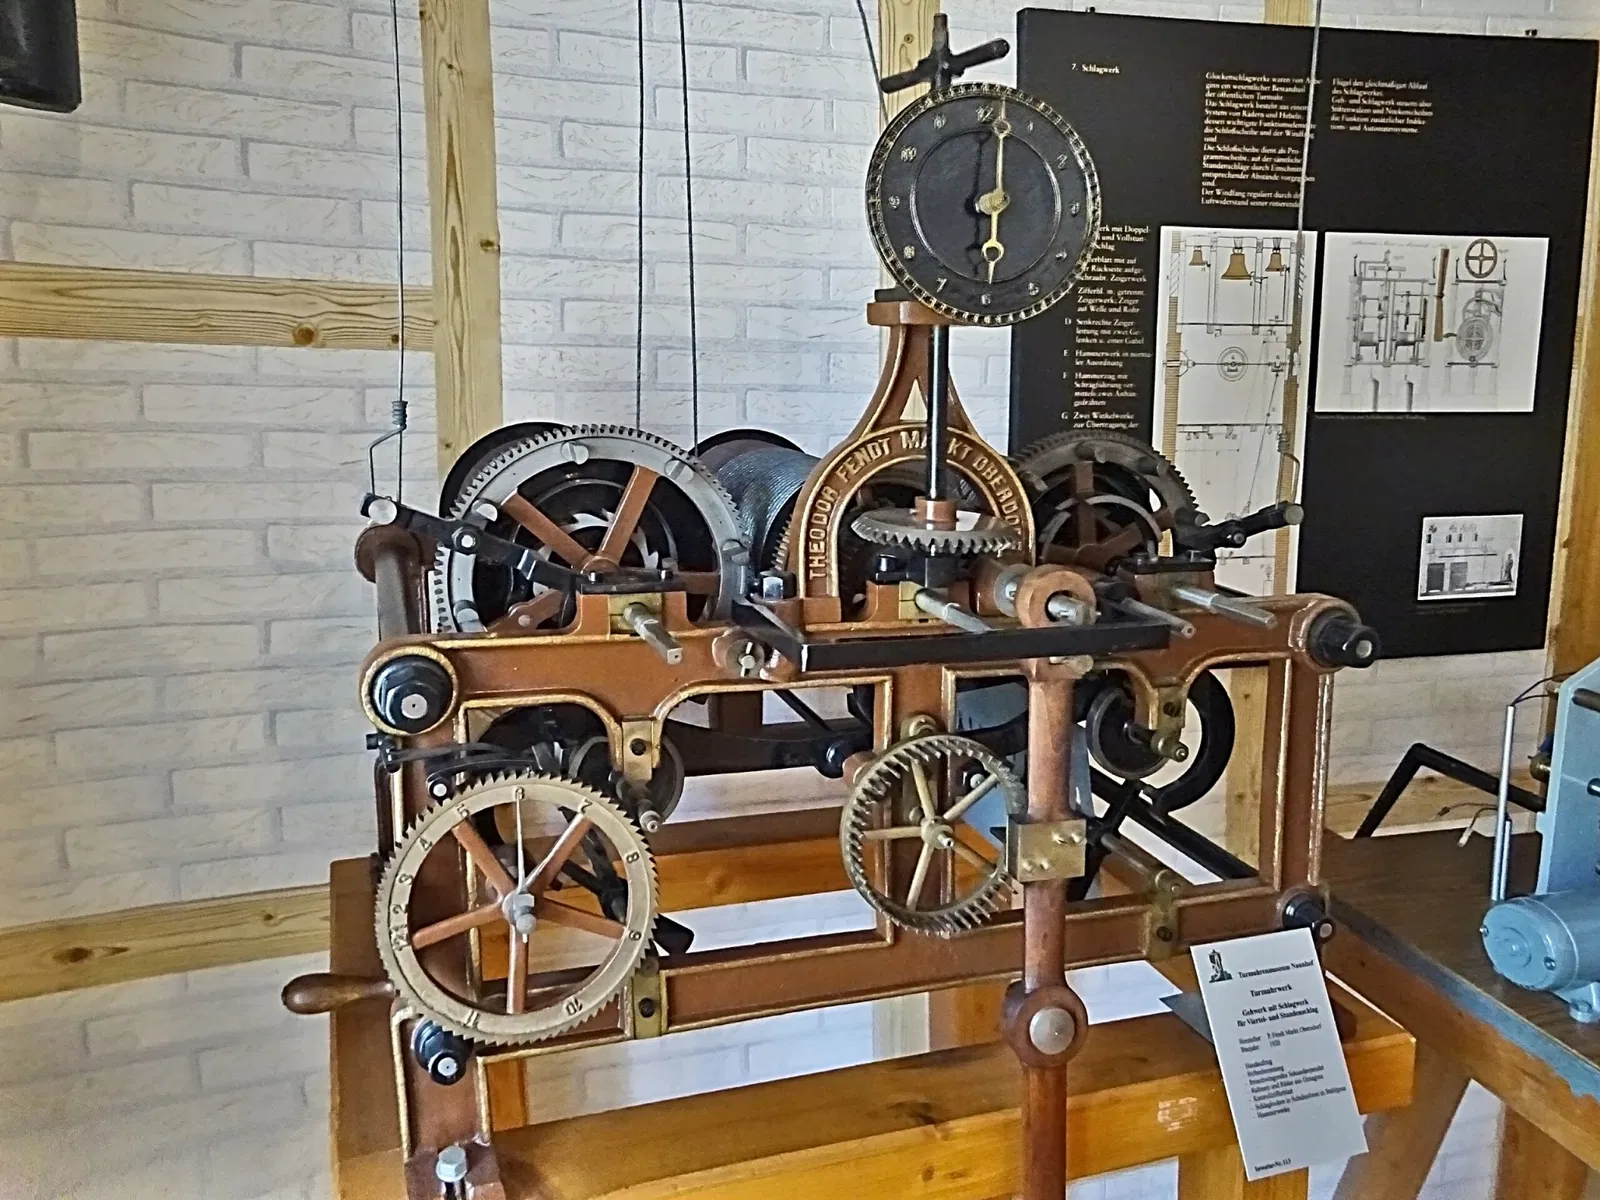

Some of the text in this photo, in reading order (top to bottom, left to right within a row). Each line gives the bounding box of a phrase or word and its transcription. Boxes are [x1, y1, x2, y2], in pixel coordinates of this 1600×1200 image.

[1082, 64, 1120, 74] Schlagwerk
[1205, 72, 1270, 83] Glockenschlagwerke
[1232, 83, 1271, 91] wesentlicher
[1219, 100, 1254, 109] Schlagwerk
[1362, 97, 1395, 106] Schlagwerk
[1205, 108, 1227, 117] System
[1386, 108, 1433, 116] Nockenscheiben
[1226, 119, 1257, 127] wichtigste
[1341, 114, 1369, 122] Funktion
[1204, 143, 1214, 151] Die
[1261, 146, 1276, 154] dient
[1057, 153, 1068, 170] 2
[1251, 163, 1269, 171] durch
[1202, 172, 1249, 180] entsprechender
[1215, 189, 1245, 198] Windfang
[1247, 190, 1272, 198] reguliert
[1201, 197, 1248, 206] Luftwiderstand
[1124, 225, 1151, 234] Doppel-
[1102, 233, 1115, 241] und
[1110, 274, 1147, 283] Zeigerwerk
[936, 277, 948, 293] 7
[1028, 281, 1040, 297] 5
[981, 292, 992, 306] 6
[1118, 297, 1139, 306] Zeiger
[1089, 305, 1107, 313] Welle
[1065, 317, 1072, 325] D
[1076, 318, 1112, 326] Senkrechte
[1061, 412, 1068, 420] G
[1091, 412, 1134, 420] Winkelwerke
[809, 485, 839, 580] THEODOR
[835, 437, 893, 483] FENDT
[900, 431, 974, 461] MAKT
[456, 804, 470, 817] 5
[578, 798, 594, 815] 7
[419, 837, 433, 852] 4
[625, 851, 640, 865] 8
[398, 873, 414, 886] 3
[392, 903, 409, 915] 2
[628, 930, 642, 943] 9
[1250, 984, 1293, 997] Turmuhrwerk
[564, 996, 583, 1016] 10
[1242, 998, 1309, 1017] Gehwerk mit Schlagwerk
[1246, 1016, 1267, 1025] Viertel-
[1268, 1013, 1280, 1021] und
[1279, 1007, 1319, 1019] Stundenschlag
